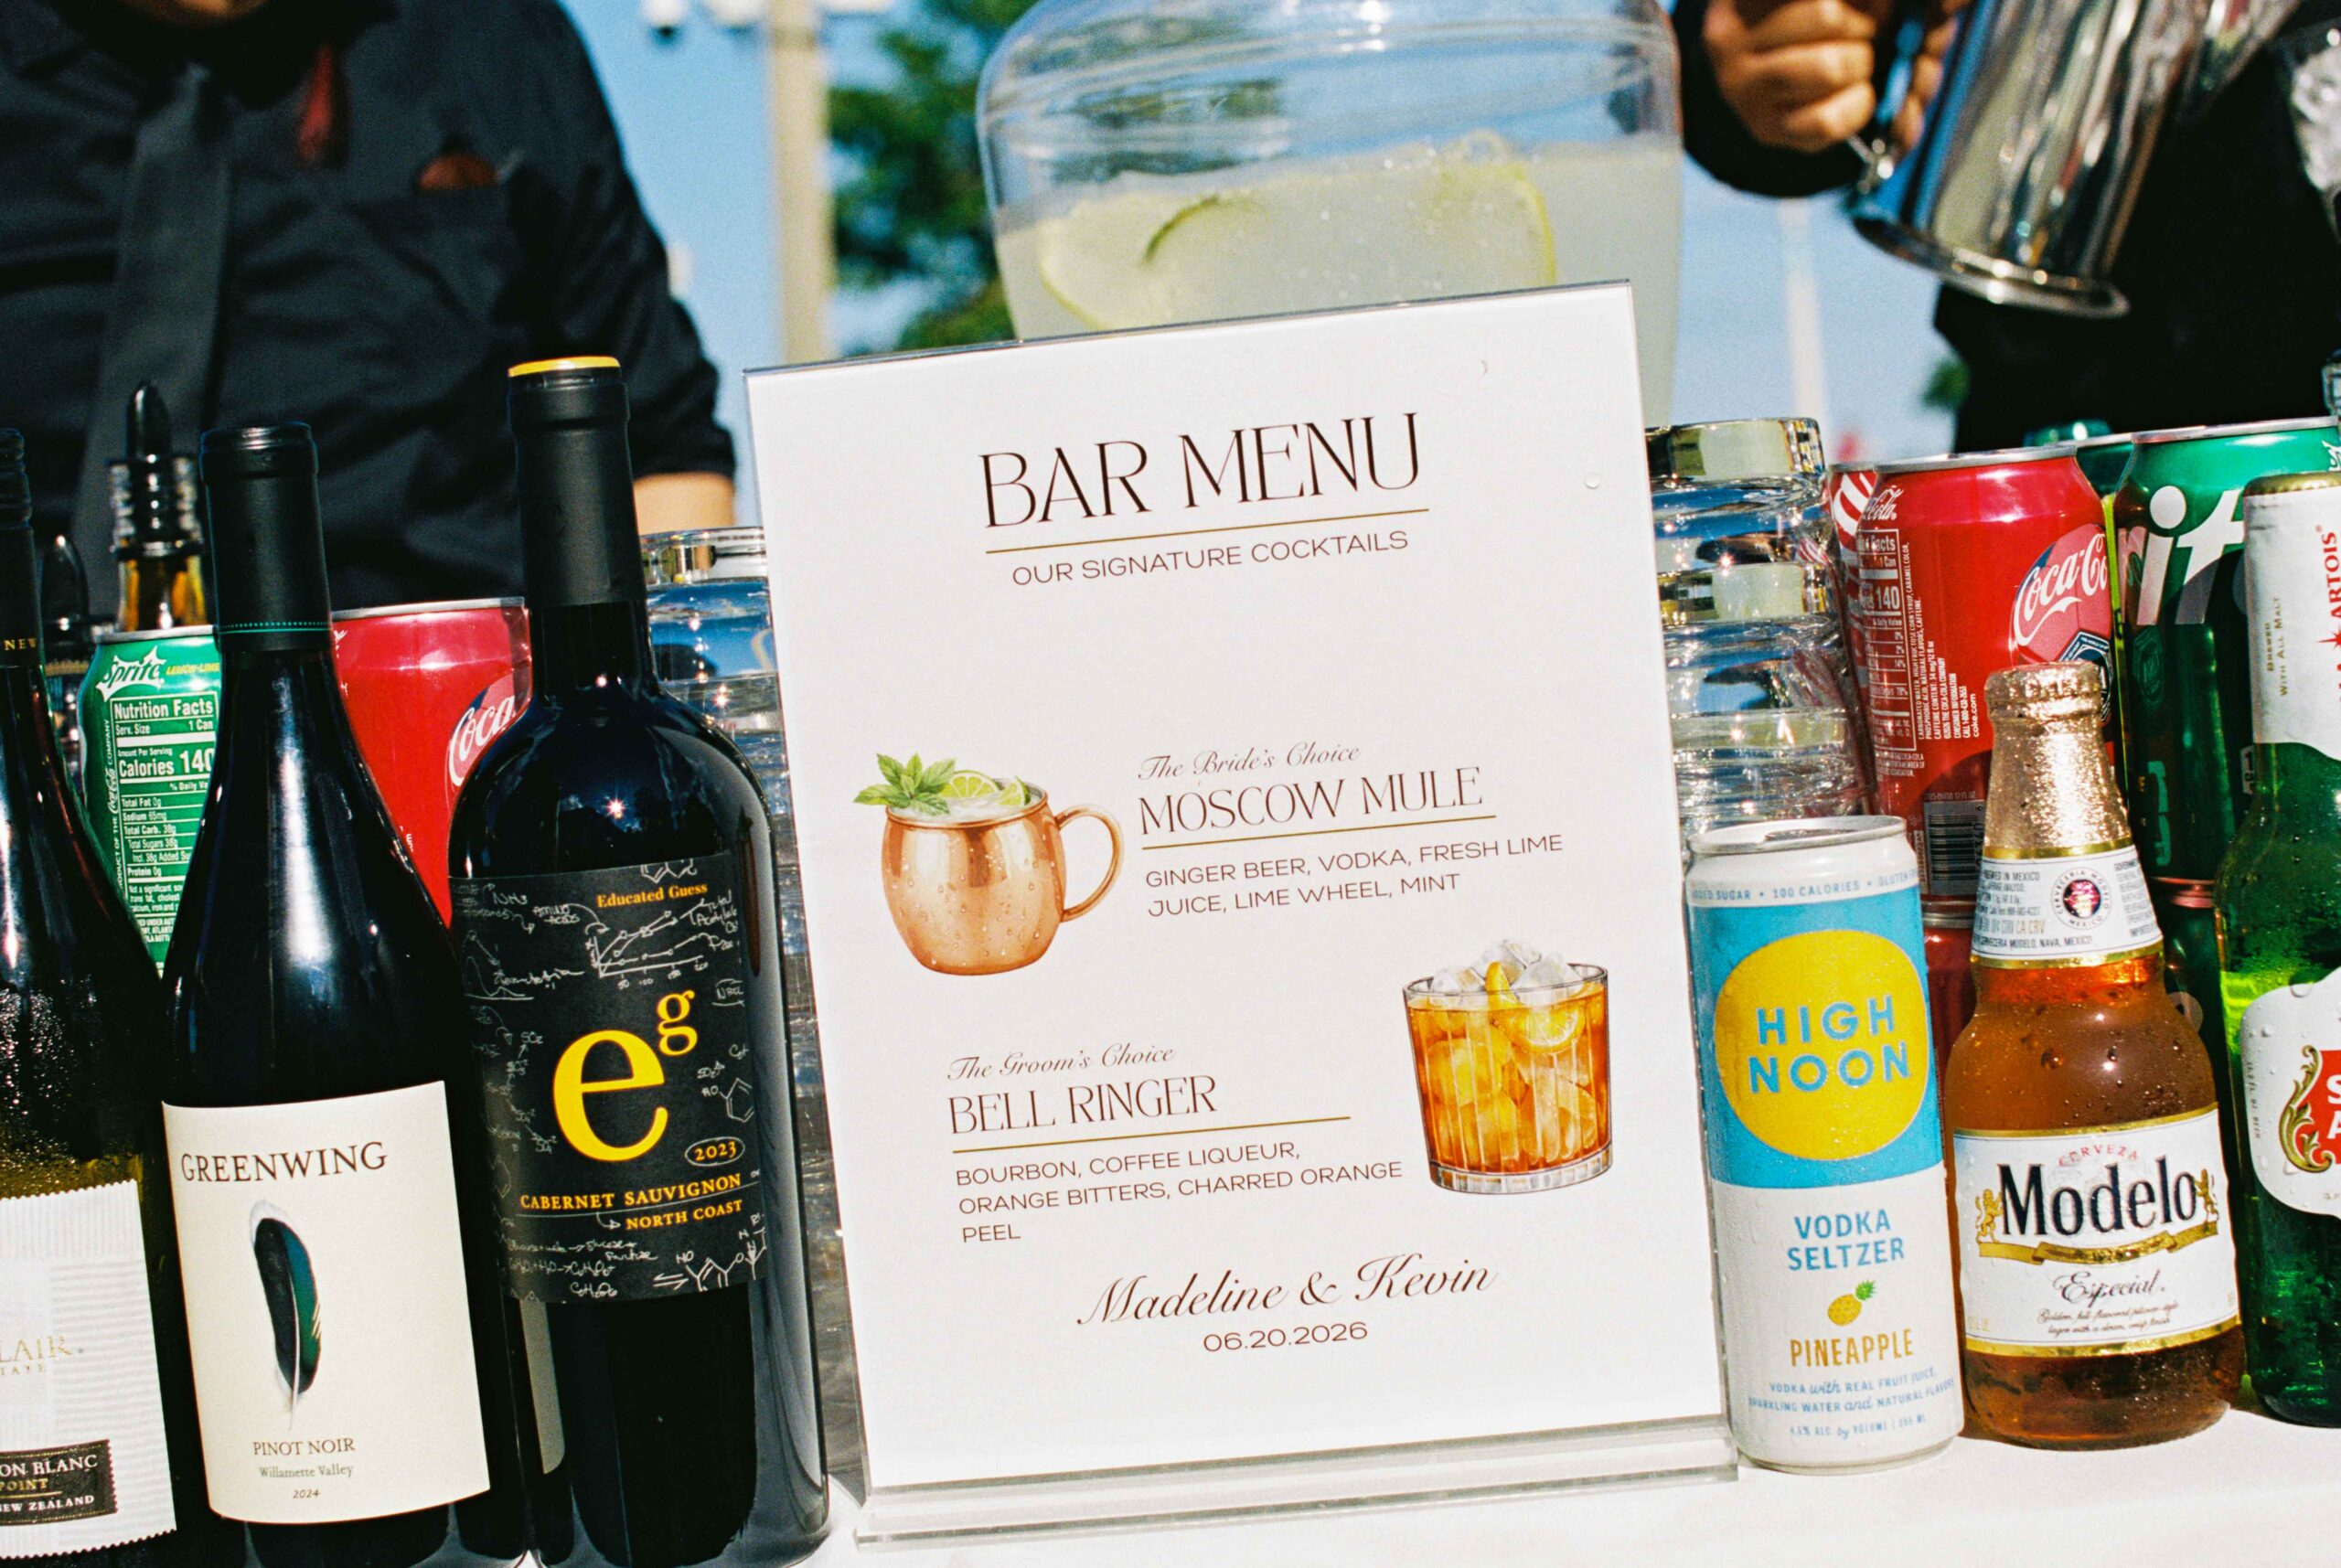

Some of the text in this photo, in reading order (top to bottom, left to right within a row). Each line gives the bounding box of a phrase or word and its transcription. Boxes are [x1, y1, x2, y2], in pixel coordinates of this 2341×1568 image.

[978, 412, 1420, 528] BAR MENU
[1871, 535, 1896, 551] Facts
[1902, 542, 1910, 564] COLOR,
[1012, 530, 1409, 586] OUR SIGNATURE COCKTAILS
[1884, 556, 1896, 567] Can
[1904, 565, 1912, 593] CARAMEL
[2321, 532, 2341, 618] ARTOIS
[1876, 586, 1900, 609] 140
[2014, 534, 2108, 645] Coca-Co
[1909, 632, 1918, 662] FRUCTOSE
[1917, 628, 1925, 657] FLAVORS,
[100, 653, 165, 690] Sprite
[1919, 657, 1928, 685] NATURAL
[1929, 672, 1937, 680] 34
[1929, 683, 1940, 710] CONTENT:
[1938, 657, 1950, 721] THE COCA-COLA COMPANY
[114, 699, 213, 720] Nutrition Facts
[1949, 673, 1962, 739] CONSUMER INFORMATION
[1970, 693, 1979, 738] coke.com
[116, 720, 213, 735] Serv. Size 1 Can
[1923, 702, 1932, 740] PHOSPHORIC
[1932, 711, 1941, 740] CAFFEINE
[1962, 725, 1971, 738] CALL
[103, 719, 113, 765] COMPANY
[138, 748, 148, 756] Per
[149, 748, 172, 756] Serving
[449, 695, 516, 787] Coca
[118, 748, 213, 778] Calories 140
[1138, 741, 1360, 781] The Bride's Choice
[179, 781, 197, 791] Daily
[122, 797, 161, 807] Total Fat 0g
[1138, 765, 1483, 836] MOSCOW MULE
[123, 812, 147, 821] Sodium
[124, 826, 140, 835] Total
[142, 825, 161, 835] Carb.
[113, 837, 120, 849] OF
[128, 837, 178, 849] Total Sugars 38g
[158, 851, 178, 861] Added
[128, 868, 161, 878] Protein 0g
[1145, 833, 1564, 889] GINGER BEER, VODKA, FRESH LIME
[144, 885, 172, 894] significant
[1715, 890, 1751, 901] SUGAR
[1773, 890, 1794, 899] 100
[1800, 880, 1860, 896] CALORIES
[1878, 874, 1908, 887] GLUTEN
[2014, 871, 2040, 880] MEXICO
[596, 882, 708, 908] Educated Guess
[1148, 872, 1461, 918] JUICE, LIME WHEEL, MINT
[2064, 935, 2092, 945] MEXICO
[1757, 994, 1895, 1045] HIGH
[946, 1041, 1176, 1082] The Groom's Choice
[1748, 1041, 1911, 1093] NOON
[948, 1074, 1218, 1135] BELL RINGER
[180, 1140, 389, 1184] GREENWING
[694, 1145, 737, 1162] 2023
[956, 1140, 1301, 1187] BOURBON, COFFEE LIQUEUR,
[2058, 1144, 2140, 1167] CERVEZA
[519, 1173, 742, 1211] CABERNET SAUVIGNON
[959, 1160, 1403, 1215] ORANGE BITTERS, CHARRED ORANGE
[1997, 1155, 2197, 1236] Modelo
[625, 1200, 743, 1231] NORTH COAST
[1794, 1209, 1891, 1240] VODKA
[961, 1224, 1021, 1244] PEEL
[1787, 1238, 1905, 1271] SELTZER
[1075, 1252, 1500, 1326] Madeline & Kevin
[1203, 1320, 1368, 1353] 06.20.2026
[1790, 1328, 1914, 1368] PINEAPPLE
[1769, 1374, 1908, 1394] VODKA with REAL FRUIT
[1748, 1392, 1924, 1413] SPARKLING WATER and NATURAL
[252, 1436, 358, 1456] PINOT NOIR
[33, 1455, 97, 1475] BLANC
[259, 1463, 355, 1479] Willamette Valley
[28, 1495, 95, 1511] ZEALAND
[292, 1488, 321, 1499] 2024
